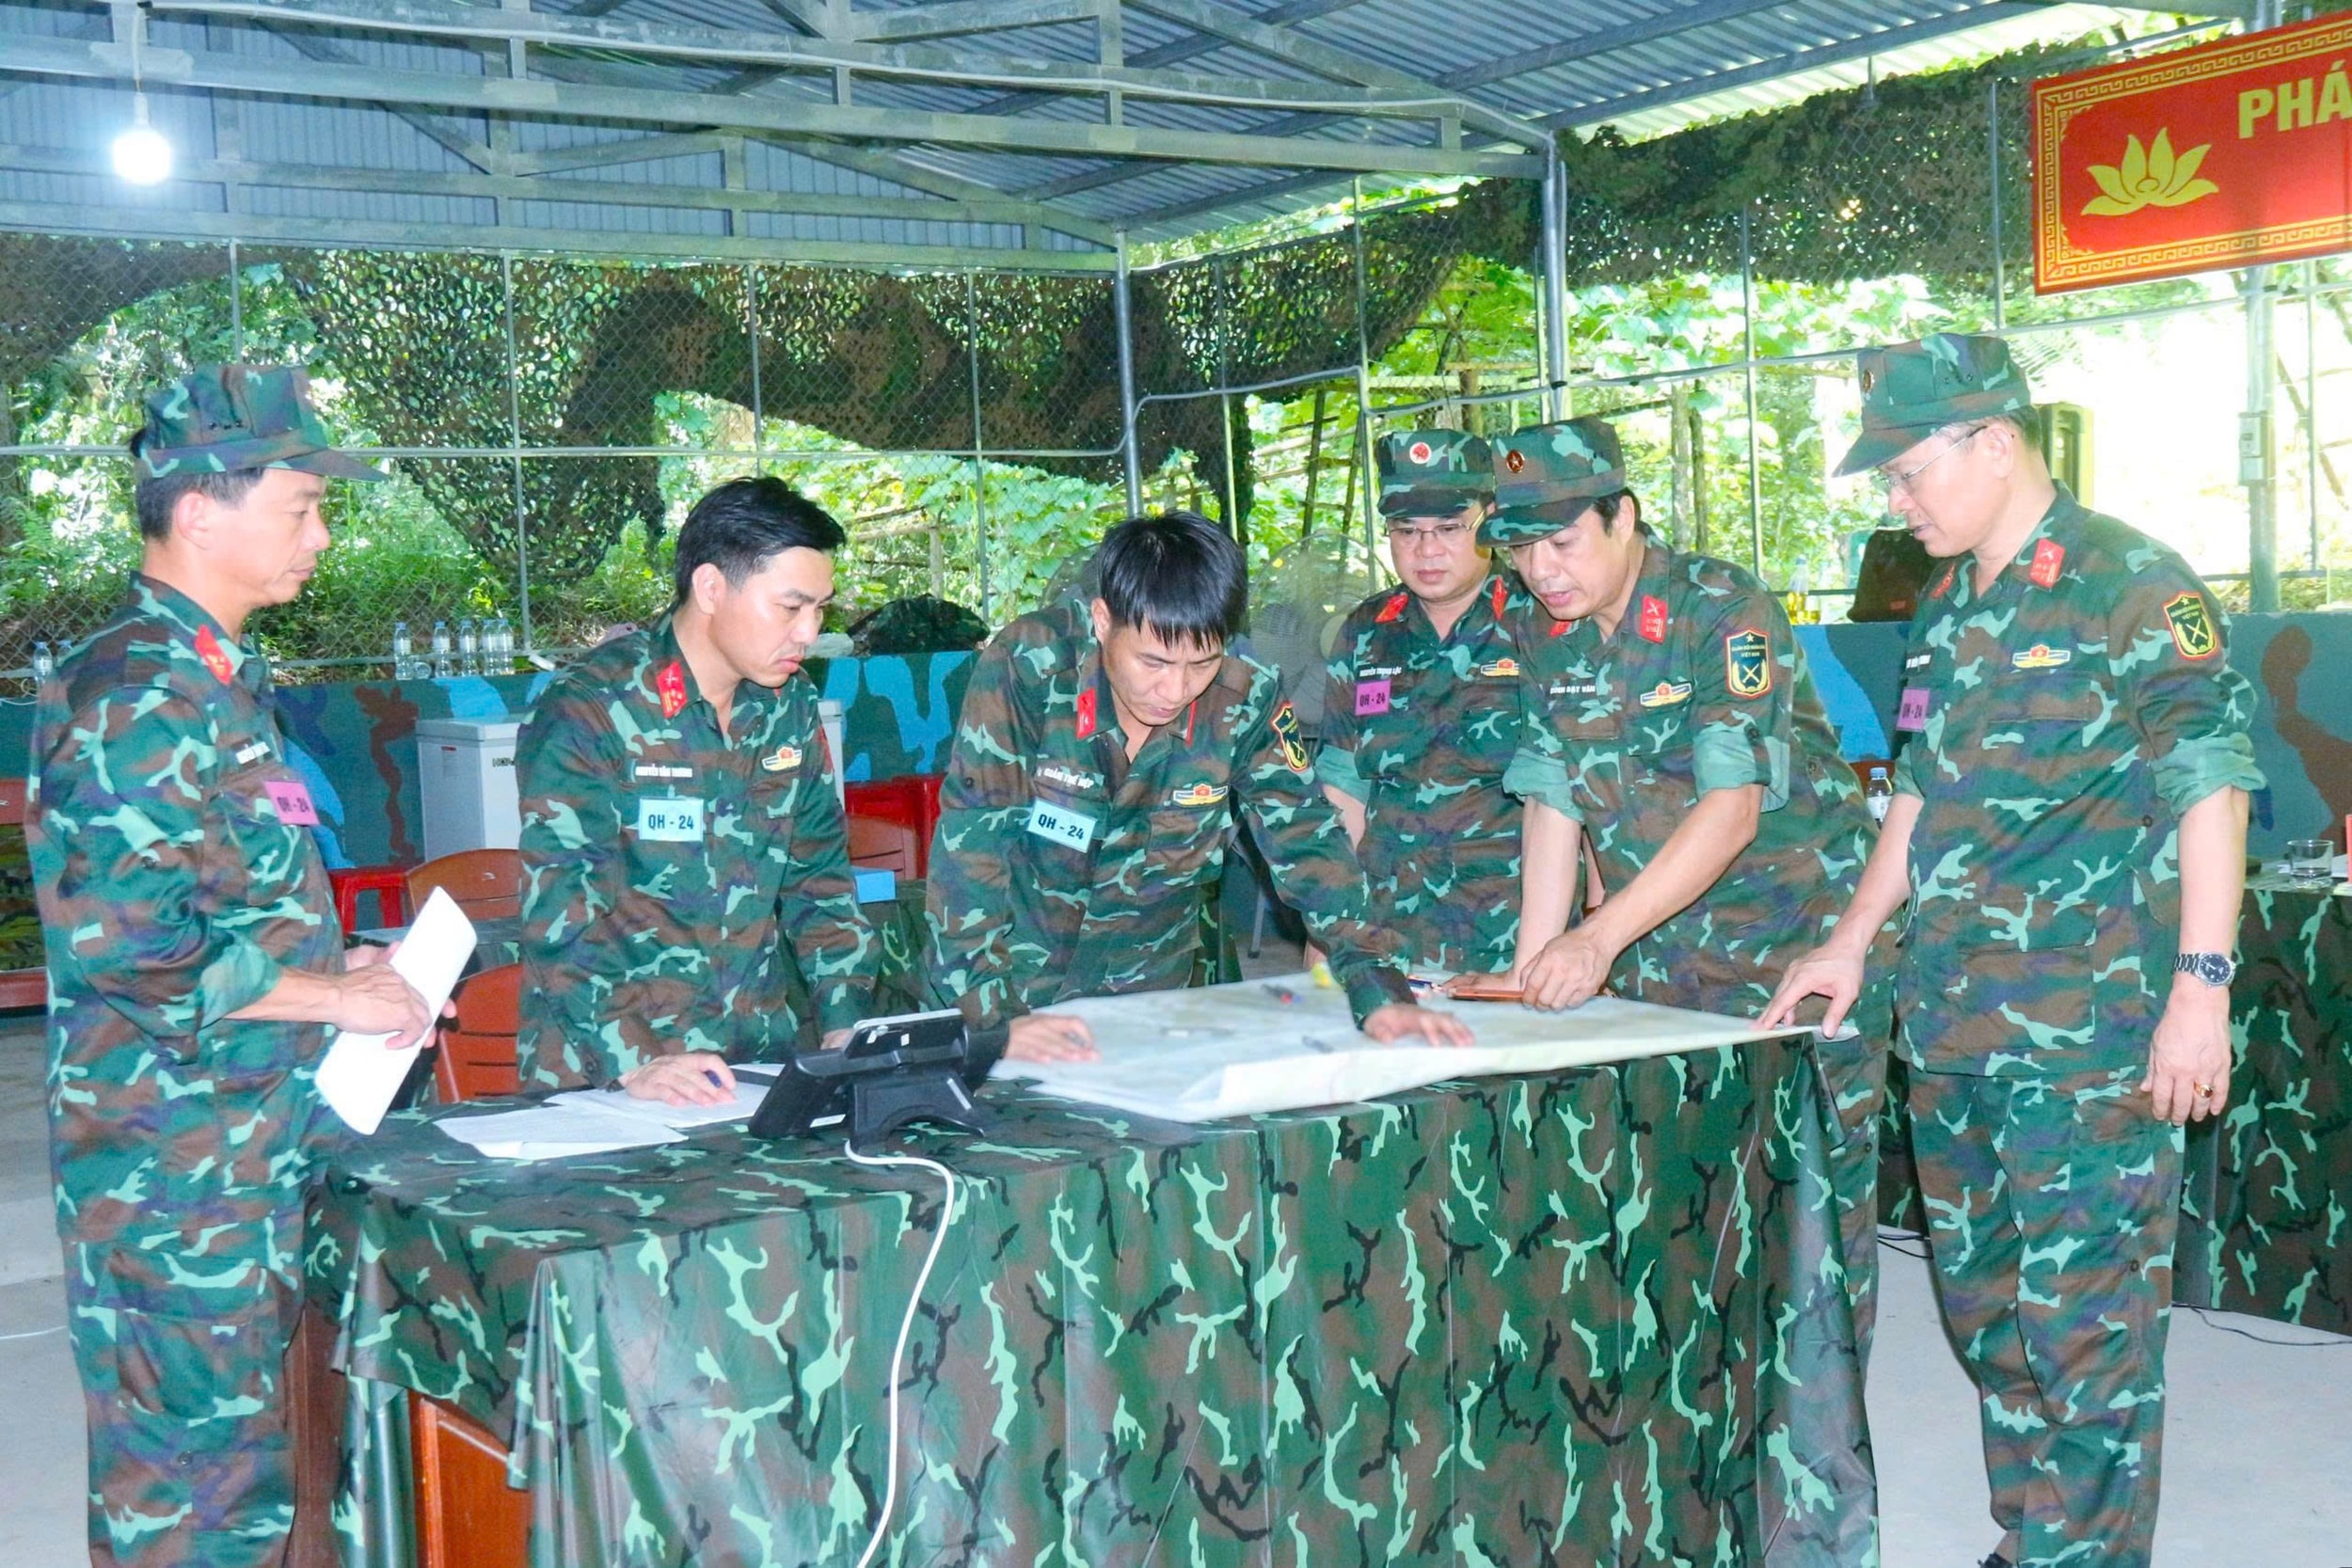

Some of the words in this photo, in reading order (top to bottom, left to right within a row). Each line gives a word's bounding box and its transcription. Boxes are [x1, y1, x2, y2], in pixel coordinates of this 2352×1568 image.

[2238, 59, 2352, 139] PHÁ
[1376, 692, 1386, 705] 24
[648, 814, 665, 831] QH
[678, 815, 693, 830] 24
[1038, 814, 1057, 830] QH
[1067, 825, 1084, 840] 24
